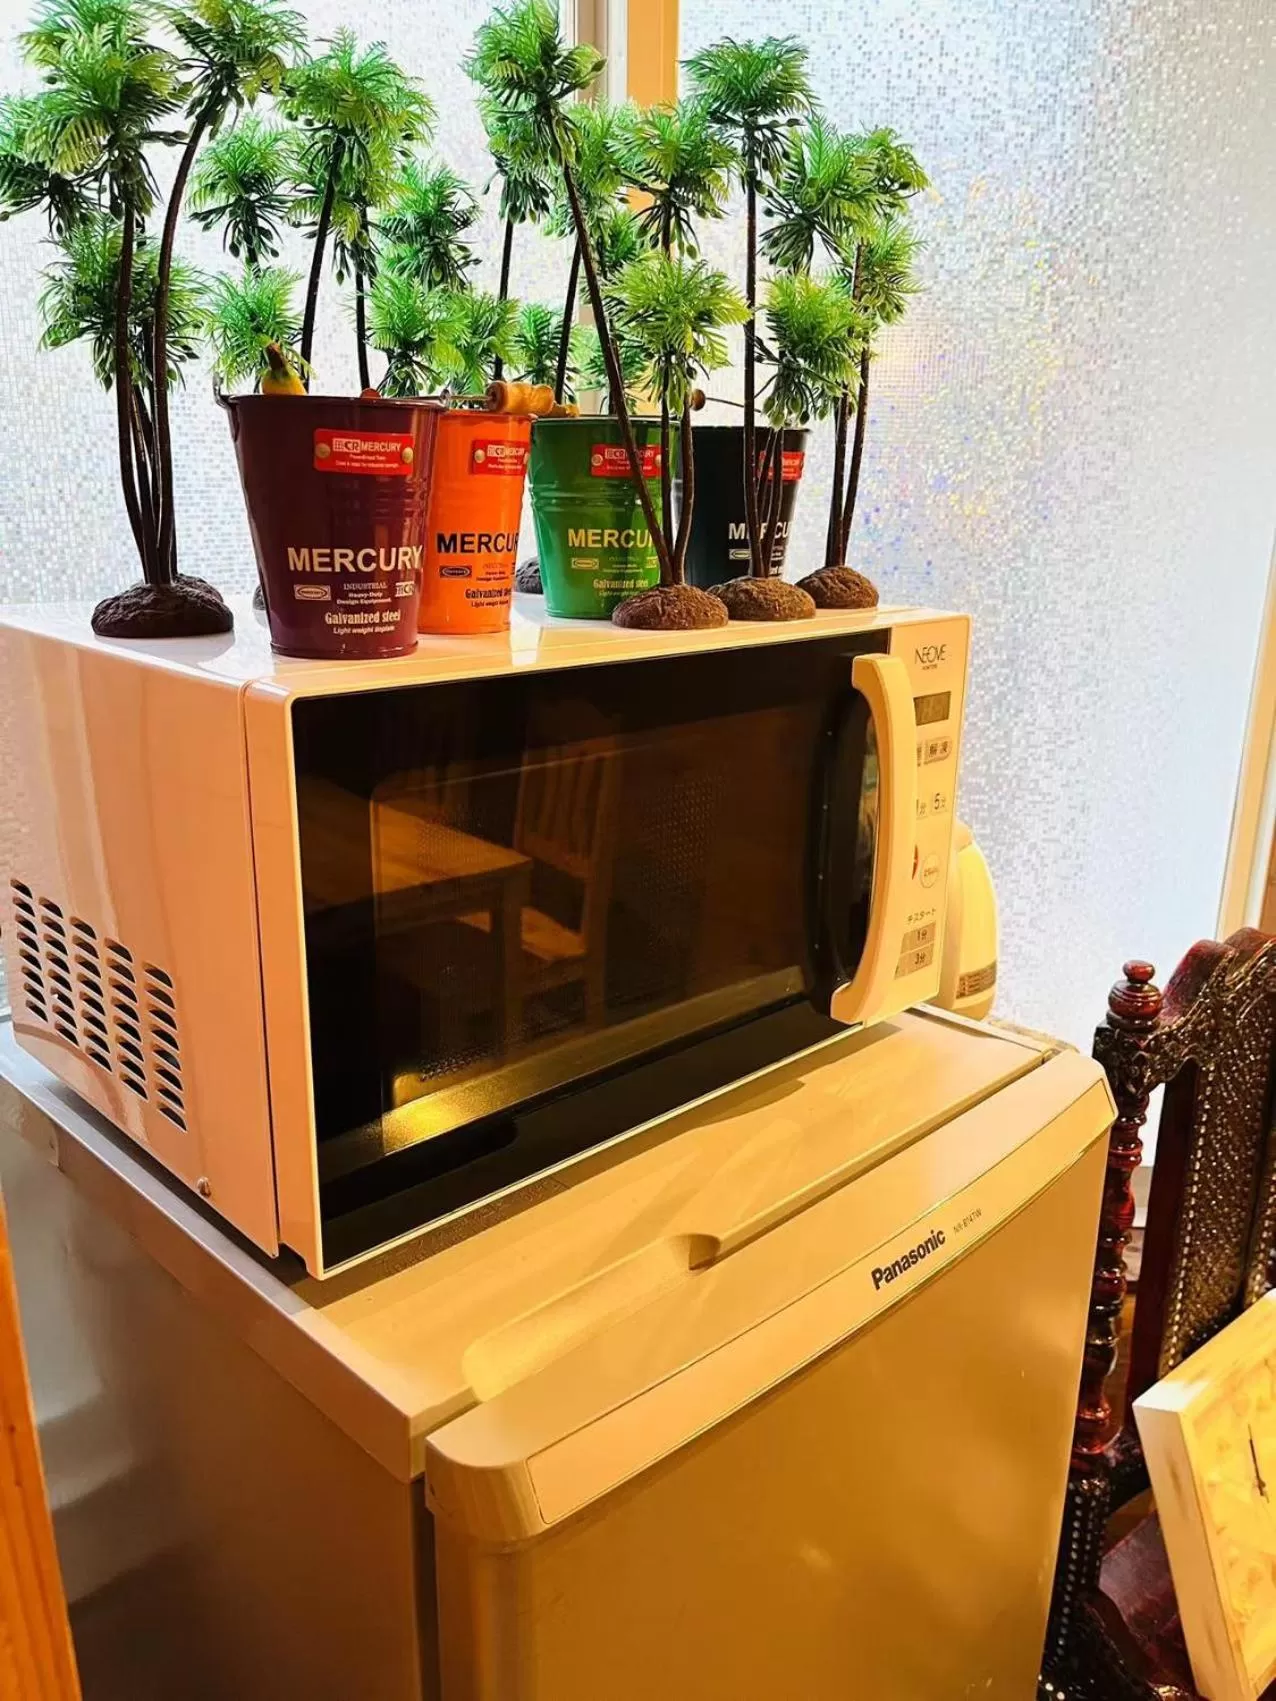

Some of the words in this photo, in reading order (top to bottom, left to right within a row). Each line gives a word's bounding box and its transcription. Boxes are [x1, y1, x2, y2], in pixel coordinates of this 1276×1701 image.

[361, 441, 401, 452] MERCURY
[287, 545, 423, 572] MERCURY
[325, 611, 380, 625] Galvanized
[382, 609, 401, 623] steel
[871, 1229, 946, 1291] Panasonic
